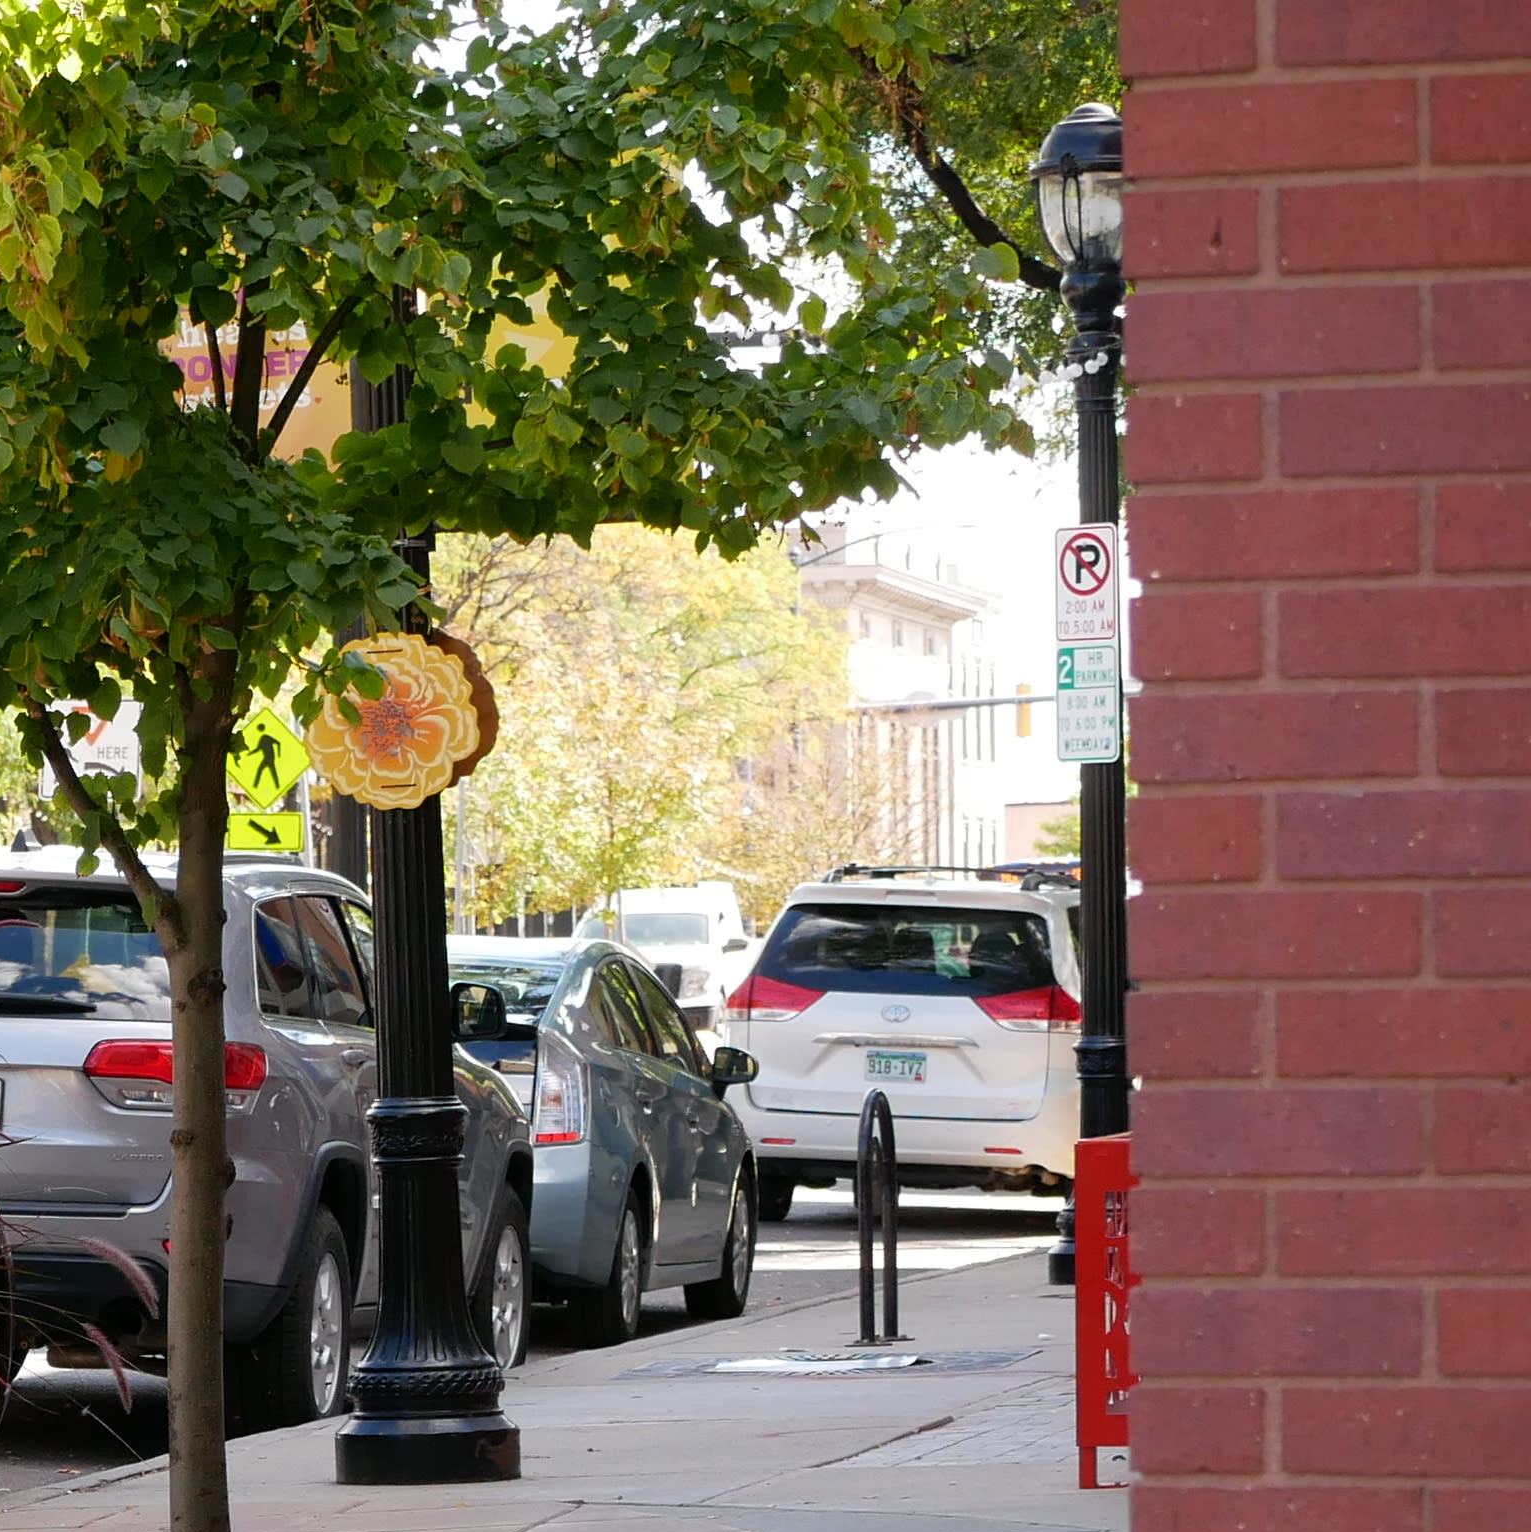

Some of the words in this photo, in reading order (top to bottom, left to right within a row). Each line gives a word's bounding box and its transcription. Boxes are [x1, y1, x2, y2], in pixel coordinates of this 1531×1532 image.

[1065, 601, 1087, 615] 2:00
[1091, 600, 1105, 613] AM
[1058, 621, 1070, 635] TO
[1074, 620, 1095, 635] 5:00
[1100, 618, 1115, 632] AM
[1088, 651, 1103, 665] HR
[1058, 655, 1072, 684] 2
[1076, 669, 1114, 682] PARKING
[1094, 695, 1106, 707] AM
[1059, 718, 1071, 732] TO
[1102, 716, 1116, 729] PM
[96, 746, 129, 761] HERE
